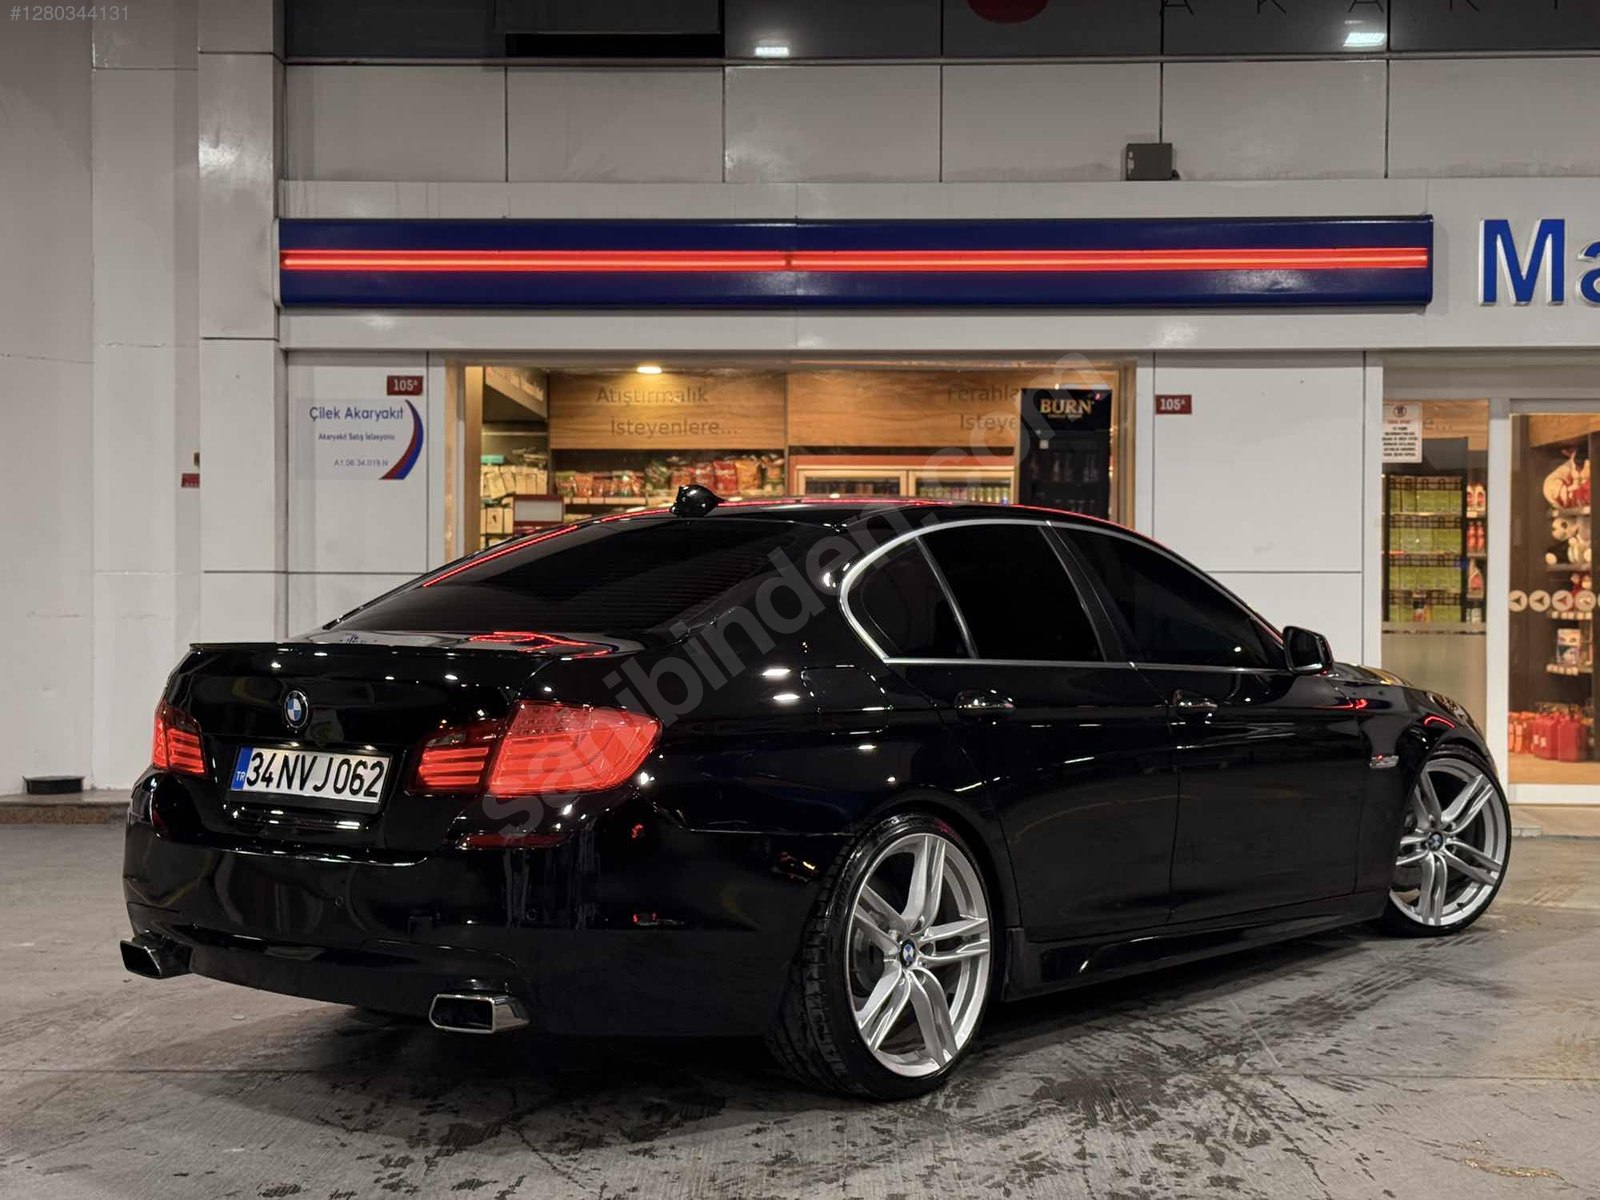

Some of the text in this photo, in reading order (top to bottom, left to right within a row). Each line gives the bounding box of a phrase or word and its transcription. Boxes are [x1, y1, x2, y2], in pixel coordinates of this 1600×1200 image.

[309, 406, 404, 422] Çilek Akaryakıt
[1040, 399, 1092, 415] BURN
